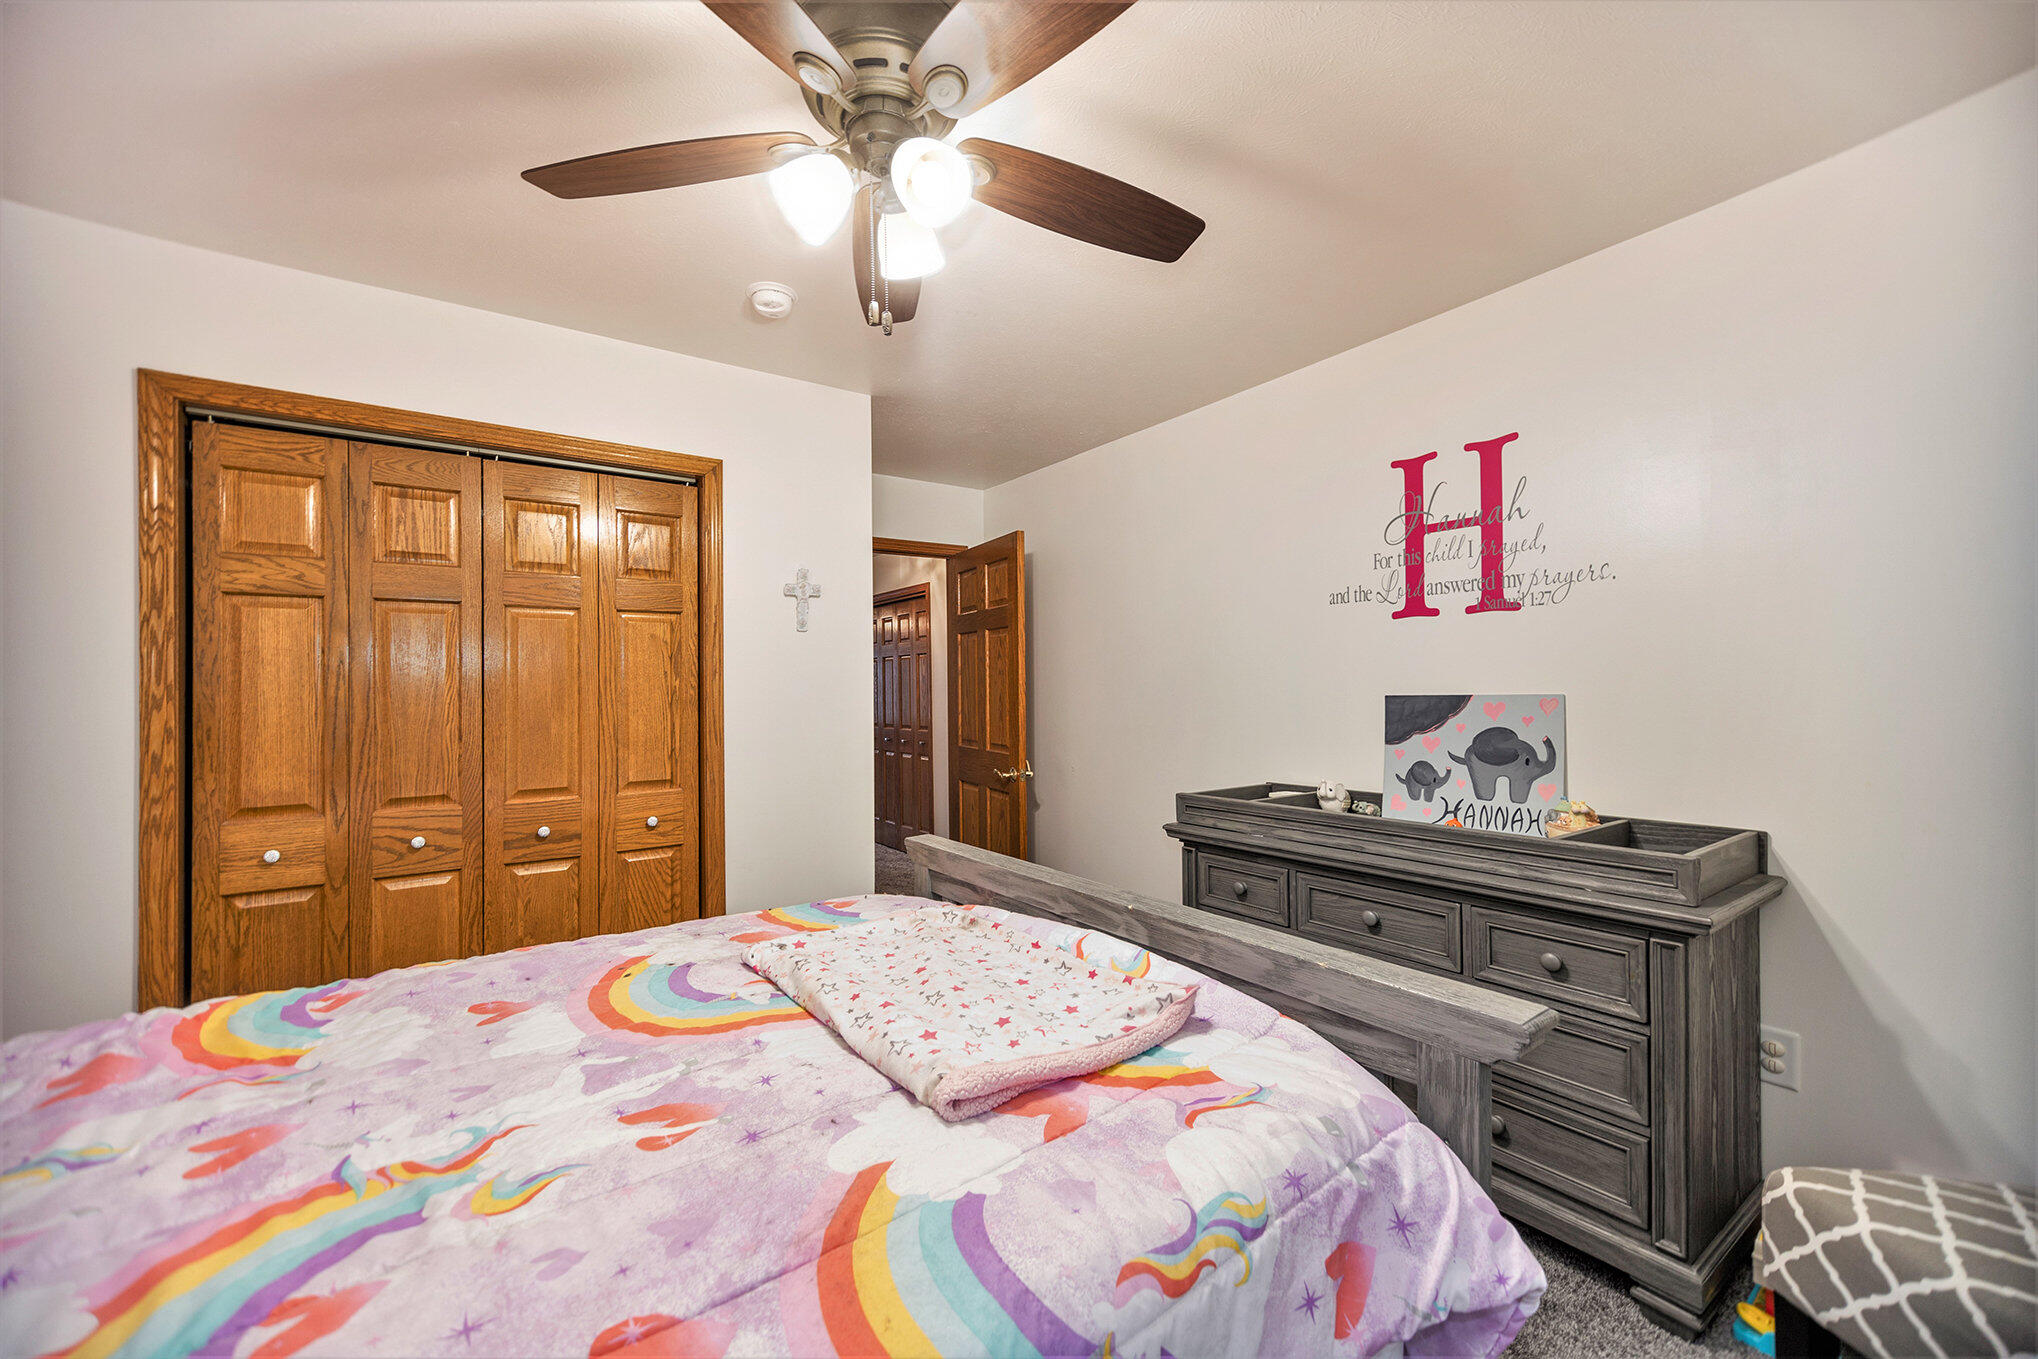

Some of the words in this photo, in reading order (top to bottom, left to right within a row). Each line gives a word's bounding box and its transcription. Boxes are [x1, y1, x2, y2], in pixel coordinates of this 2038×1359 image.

[1383, 476, 1530, 546] Hannah
[1390, 432, 1521, 620] H
[1373, 552, 1394, 570] For
[1397, 548, 1422, 567] this
[1425, 534, 1466, 563] child
[1467, 522, 1546, 573] prayed,
[1467, 540, 1473, 558] I
[1329, 586, 1350, 605] and
[1354, 585, 1373, 603] the
[1376, 569, 1425, 605] Lord
[1426, 570, 1496, 596] answered
[1501, 573, 1525, 594] my
[1519, 562, 1616, 605] prayers.
[1475, 597, 1481, 611] 1
[1484, 592, 1525, 610] Samuel
[1530, 590, 1552, 606] 1:27
[1432, 796, 1544, 836] HANNAH
